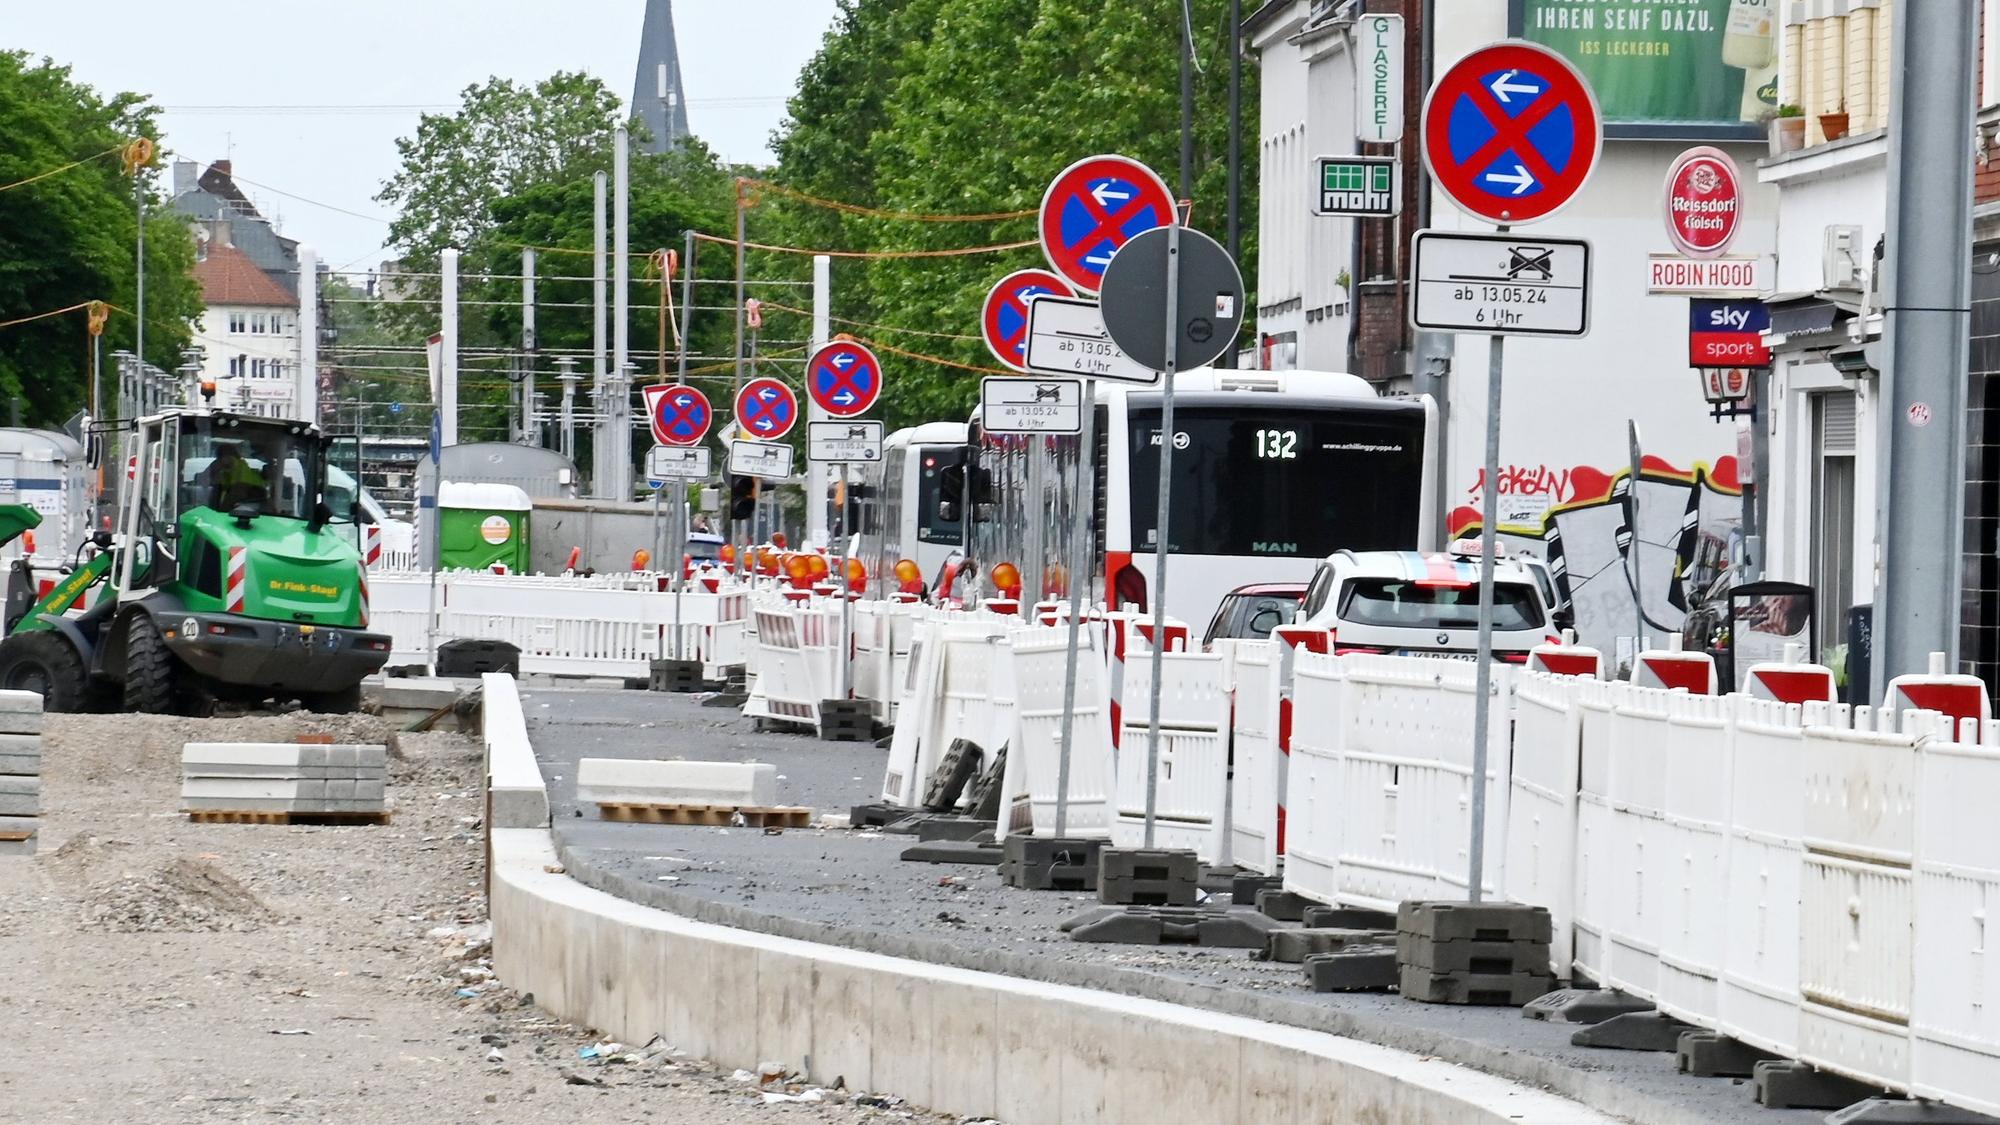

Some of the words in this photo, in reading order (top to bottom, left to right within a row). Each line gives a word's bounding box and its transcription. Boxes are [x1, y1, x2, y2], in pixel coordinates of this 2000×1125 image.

[1536, 7, 1594, 30] IHREN
[1604, 9, 1651, 31] SENF
[1661, 9, 1714, 32] DAZU.
[1580, 41, 1600, 55] ISS
[1607, 41, 1670, 56] LECKERER
[1373, 17, 1389, 139] GLASEREI
[1324, 165, 1390, 210] mohr
[1672, 197, 1735, 213] Reissdorf
[1684, 214, 1724, 231] Kölsch
[1653, 263, 1704, 286] ROBIN
[1709, 263, 1753, 287] HOOD
[1454, 286, 1474, 301] ab
[1482, 286, 1547, 304] 13.05.24
[1476, 308, 1485, 322] 6
[1493, 308, 1523, 324] Uhr
[1710, 306, 1751, 330] sky
[1059, 340, 1075, 351] ab
[1081, 342, 1122, 358] 13.05.2
[1706, 342, 1754, 357] sport
[1075, 358, 1082, 369] 6
[1005, 407, 1017, 416] ab
[1021, 407, 1059, 417] 13.05.24
[1018, 420, 1024, 428] 6
[1256, 429, 1297, 459] 132
[1252, 542, 1298, 553] MAN
[184, 622, 196, 637] 20
